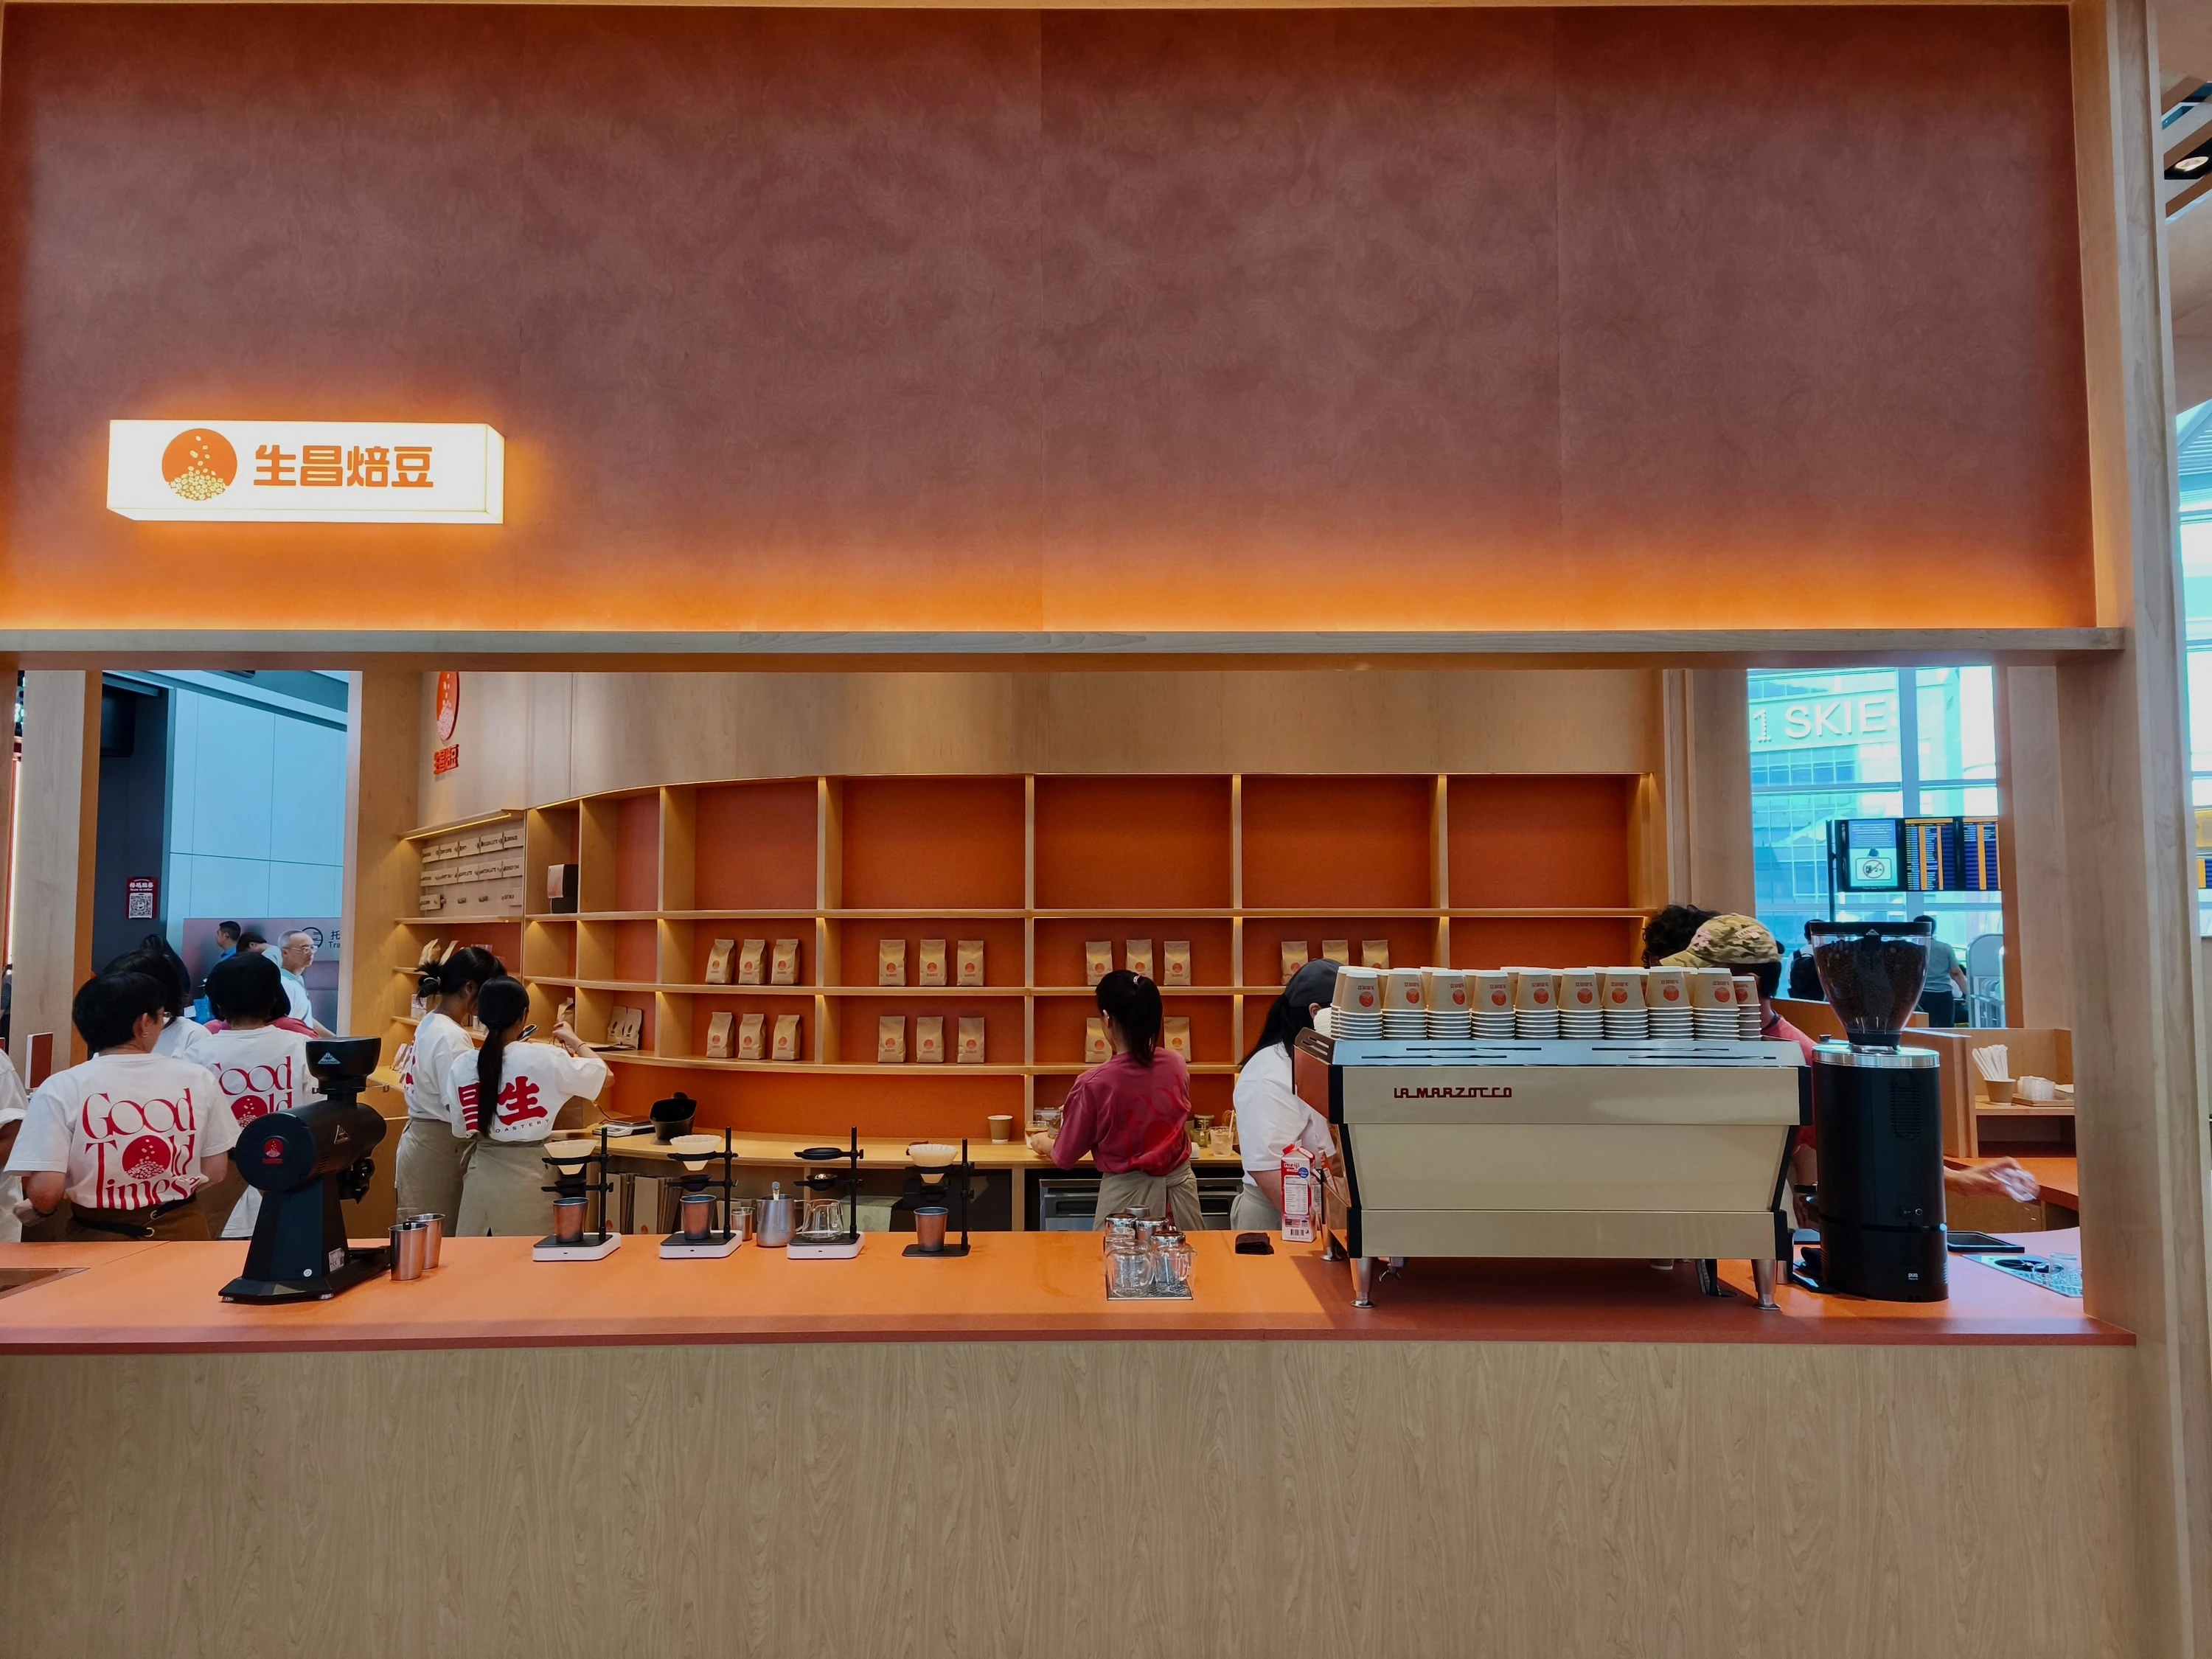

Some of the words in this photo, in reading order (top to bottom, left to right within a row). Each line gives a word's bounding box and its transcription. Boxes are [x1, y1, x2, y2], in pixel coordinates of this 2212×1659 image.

[253, 444, 434, 488] 生昌焙豆
[83, 1088, 197, 1139] Good
[1394, 1088, 1409, 1098] LA
[1416, 1088, 1512, 1098] MARZOCCO
